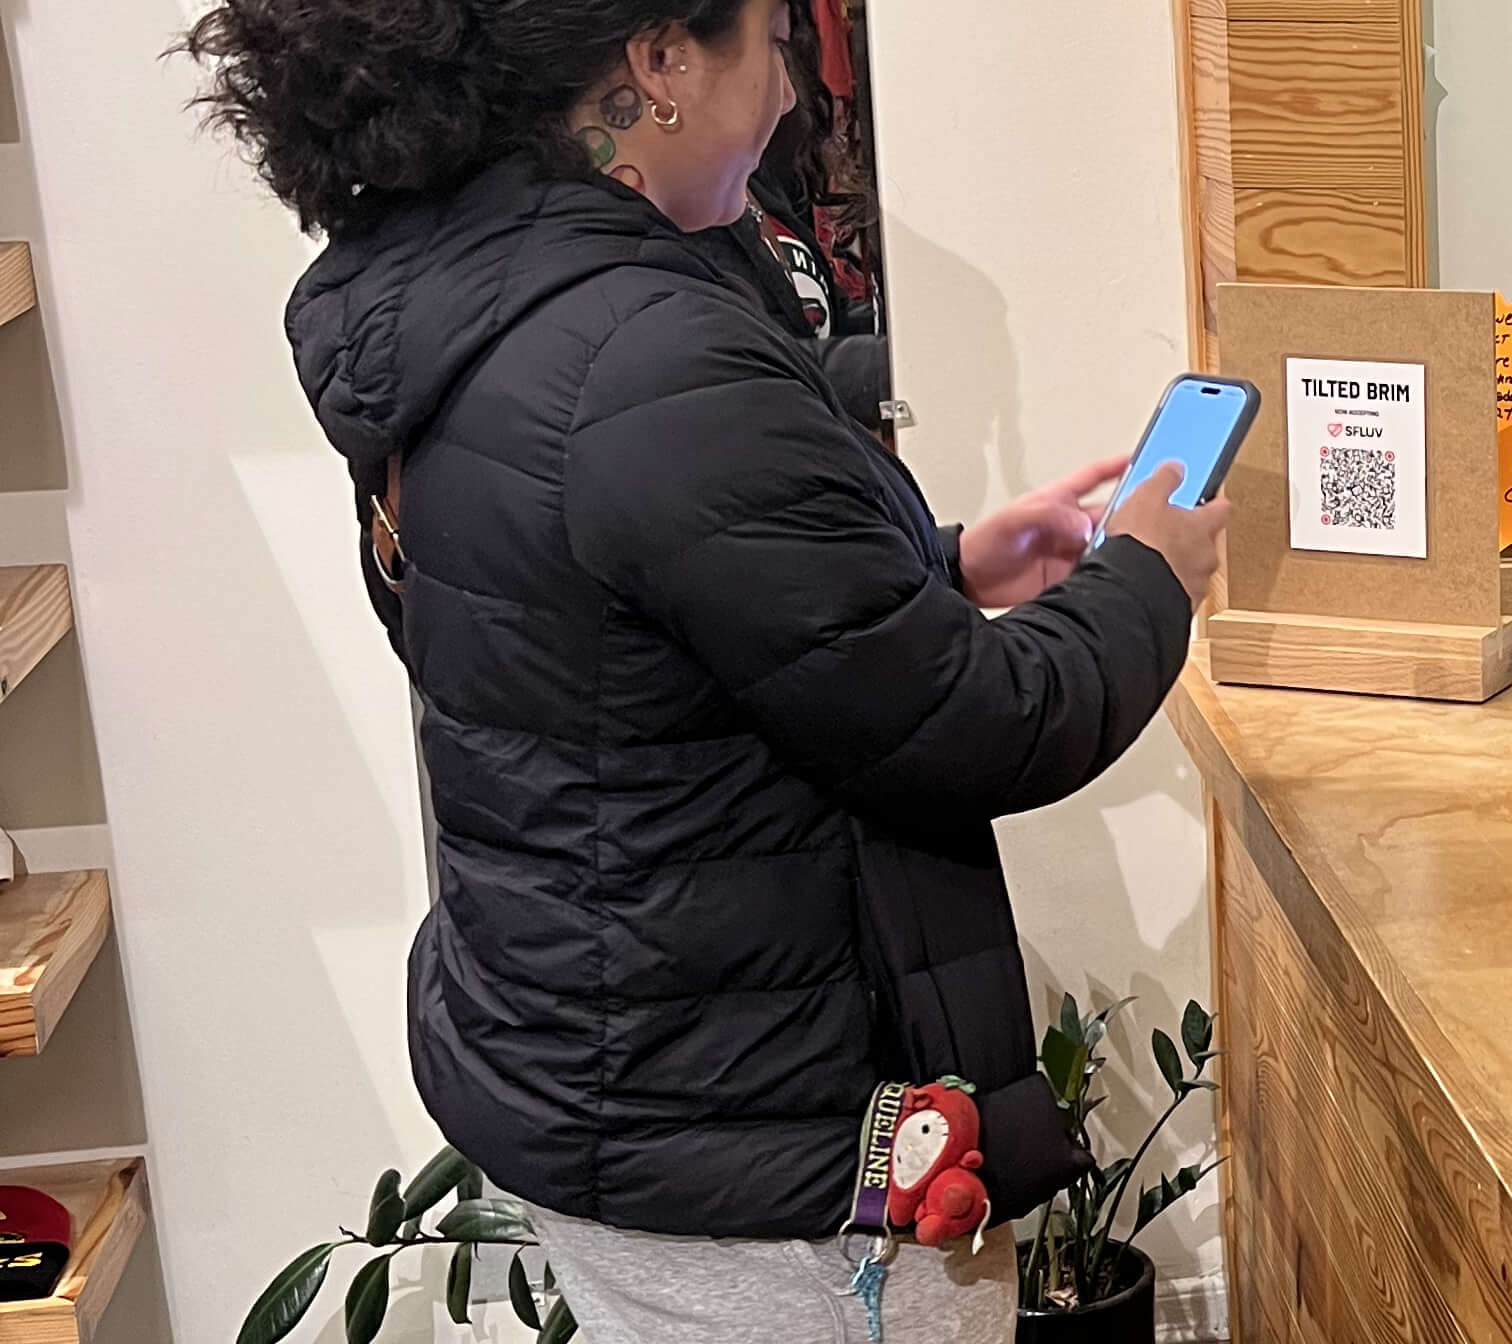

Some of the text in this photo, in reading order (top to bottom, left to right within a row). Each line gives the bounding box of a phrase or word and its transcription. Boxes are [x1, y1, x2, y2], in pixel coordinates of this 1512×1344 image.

[1301, 378, 1410, 402] TILTED BRIM
[1345, 426, 1383, 438] SFLUV
